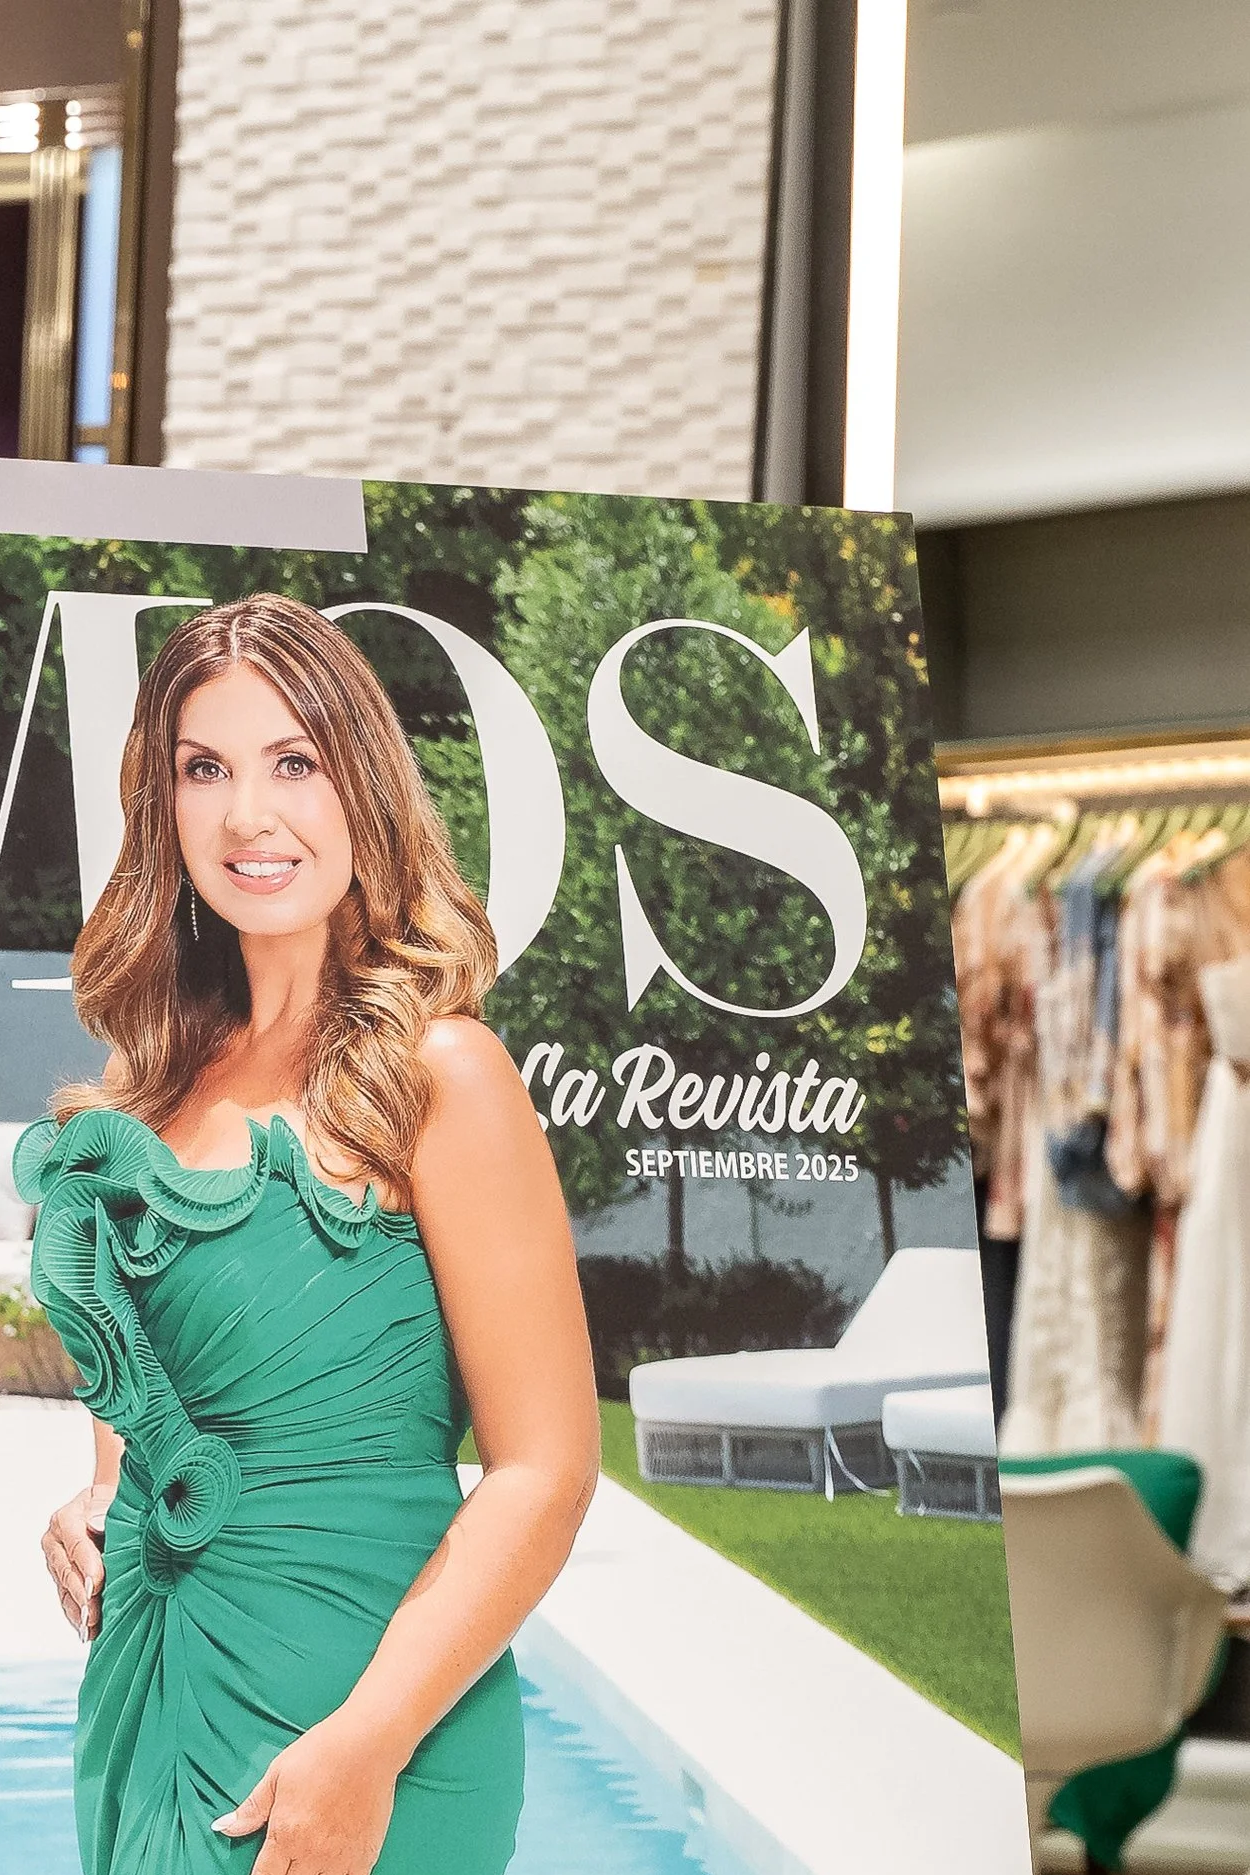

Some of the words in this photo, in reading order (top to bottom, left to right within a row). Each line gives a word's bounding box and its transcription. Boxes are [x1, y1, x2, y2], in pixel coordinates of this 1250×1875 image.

[612, 1043, 867, 1135] Revista
[625, 1148, 790, 1181] SEPTIEMBRE
[796, 1153, 859, 1182] 2025
